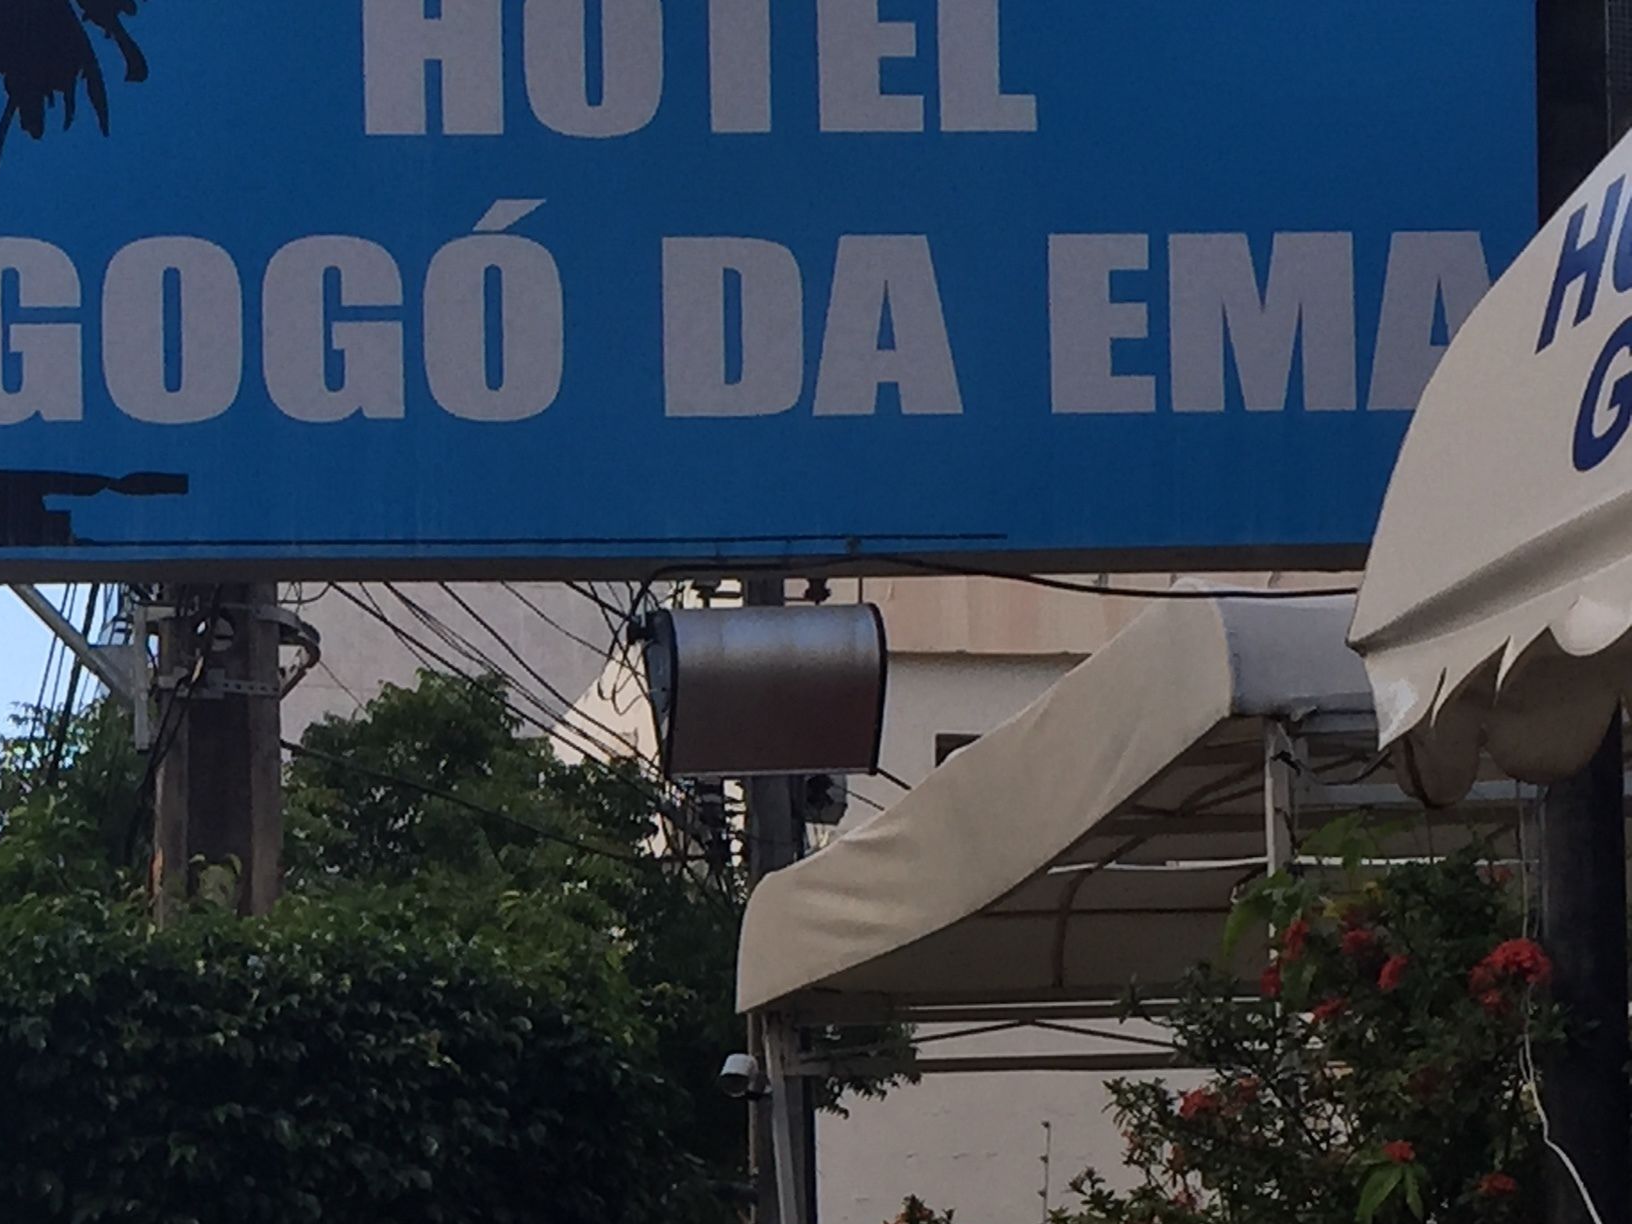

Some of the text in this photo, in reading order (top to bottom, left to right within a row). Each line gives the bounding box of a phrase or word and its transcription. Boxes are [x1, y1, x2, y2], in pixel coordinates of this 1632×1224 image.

[662, 234, 964, 417] DA
[1048, 230, 1490, 414] EMA
[1534, 174, 1632, 355] H
